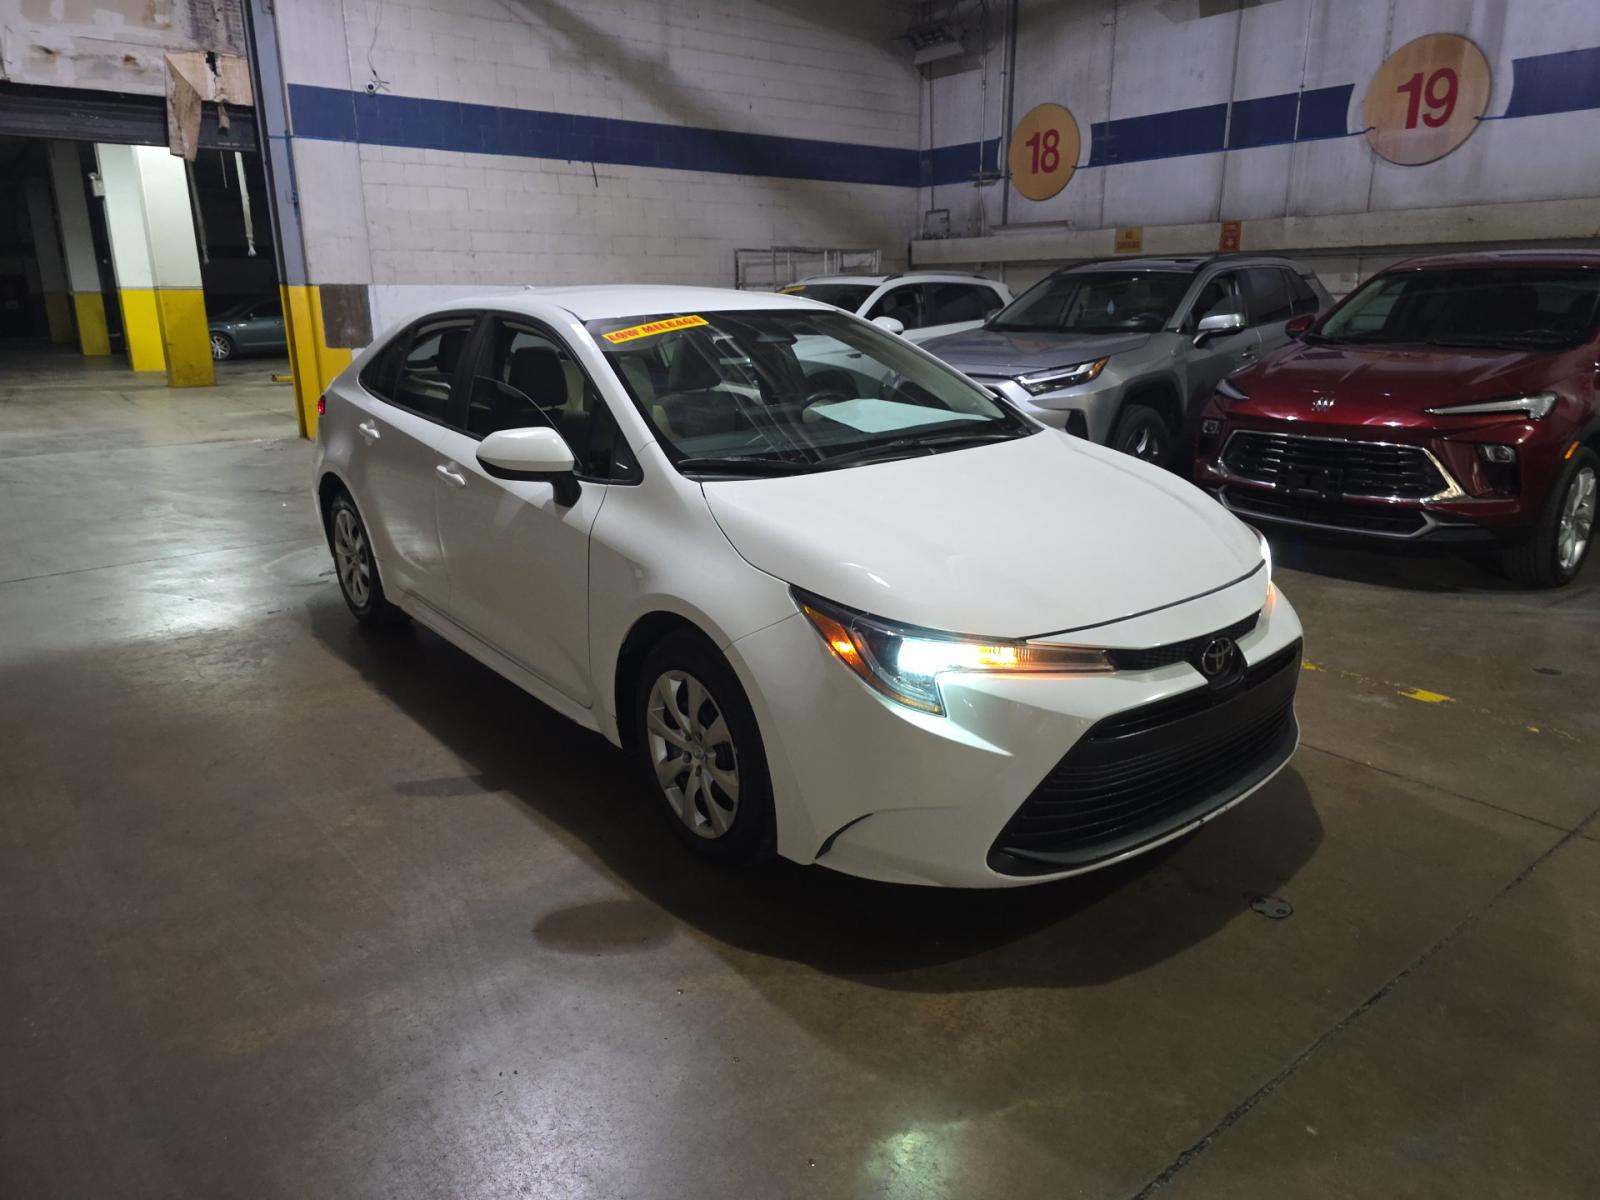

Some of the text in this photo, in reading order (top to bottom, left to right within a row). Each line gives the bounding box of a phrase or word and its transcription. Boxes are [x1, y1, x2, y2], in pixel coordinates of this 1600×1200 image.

[1397, 67, 1458, 129] 19
[1025, 130, 1060, 175] 18
[608, 316, 701, 341] LOW MILEAGE
